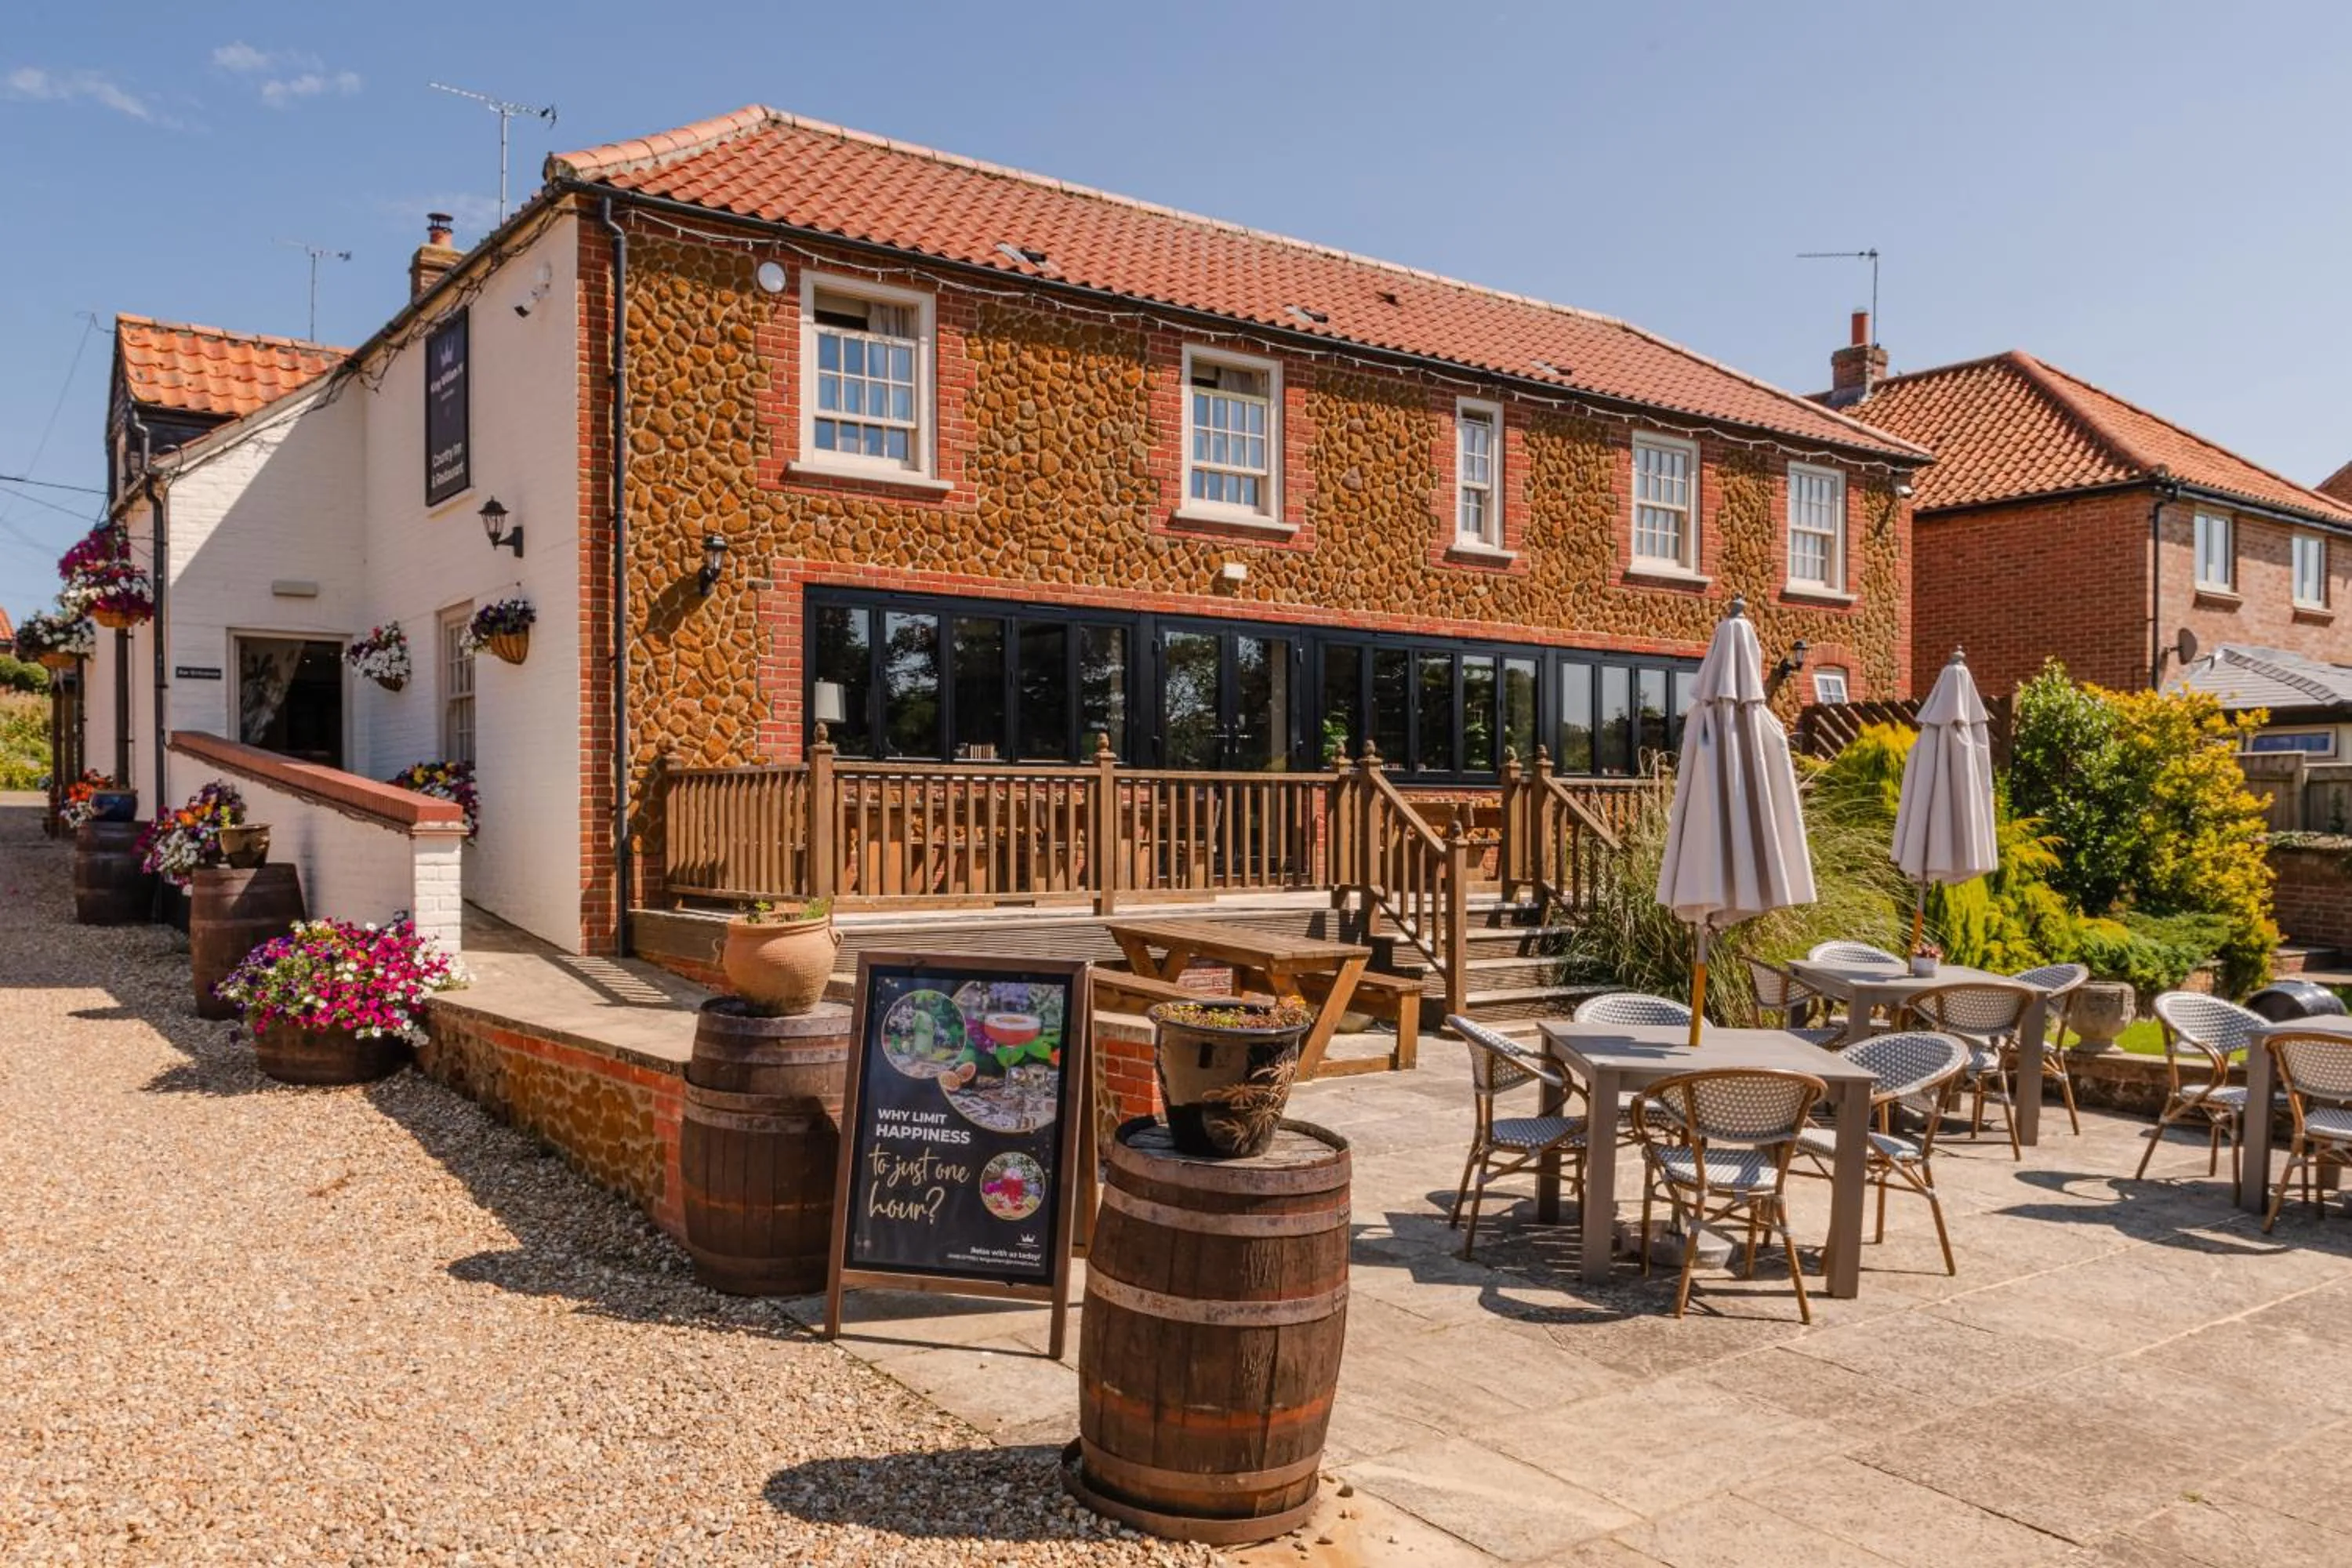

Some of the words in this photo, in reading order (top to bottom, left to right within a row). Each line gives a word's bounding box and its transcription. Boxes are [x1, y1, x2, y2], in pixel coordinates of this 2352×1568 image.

[433, 449, 452, 467] Country
[436, 459, 463, 485] Restaurant
[877, 1108, 909, 1121] WHY
[912, 1112, 947, 1123] LIMIT
[876, 1123, 971, 1144] HAPPINESS
[869, 1142, 891, 1176] to
[887, 1146, 941, 1188] just
[935, 1163, 970, 1183] one
[869, 1181, 945, 1225] hour?
